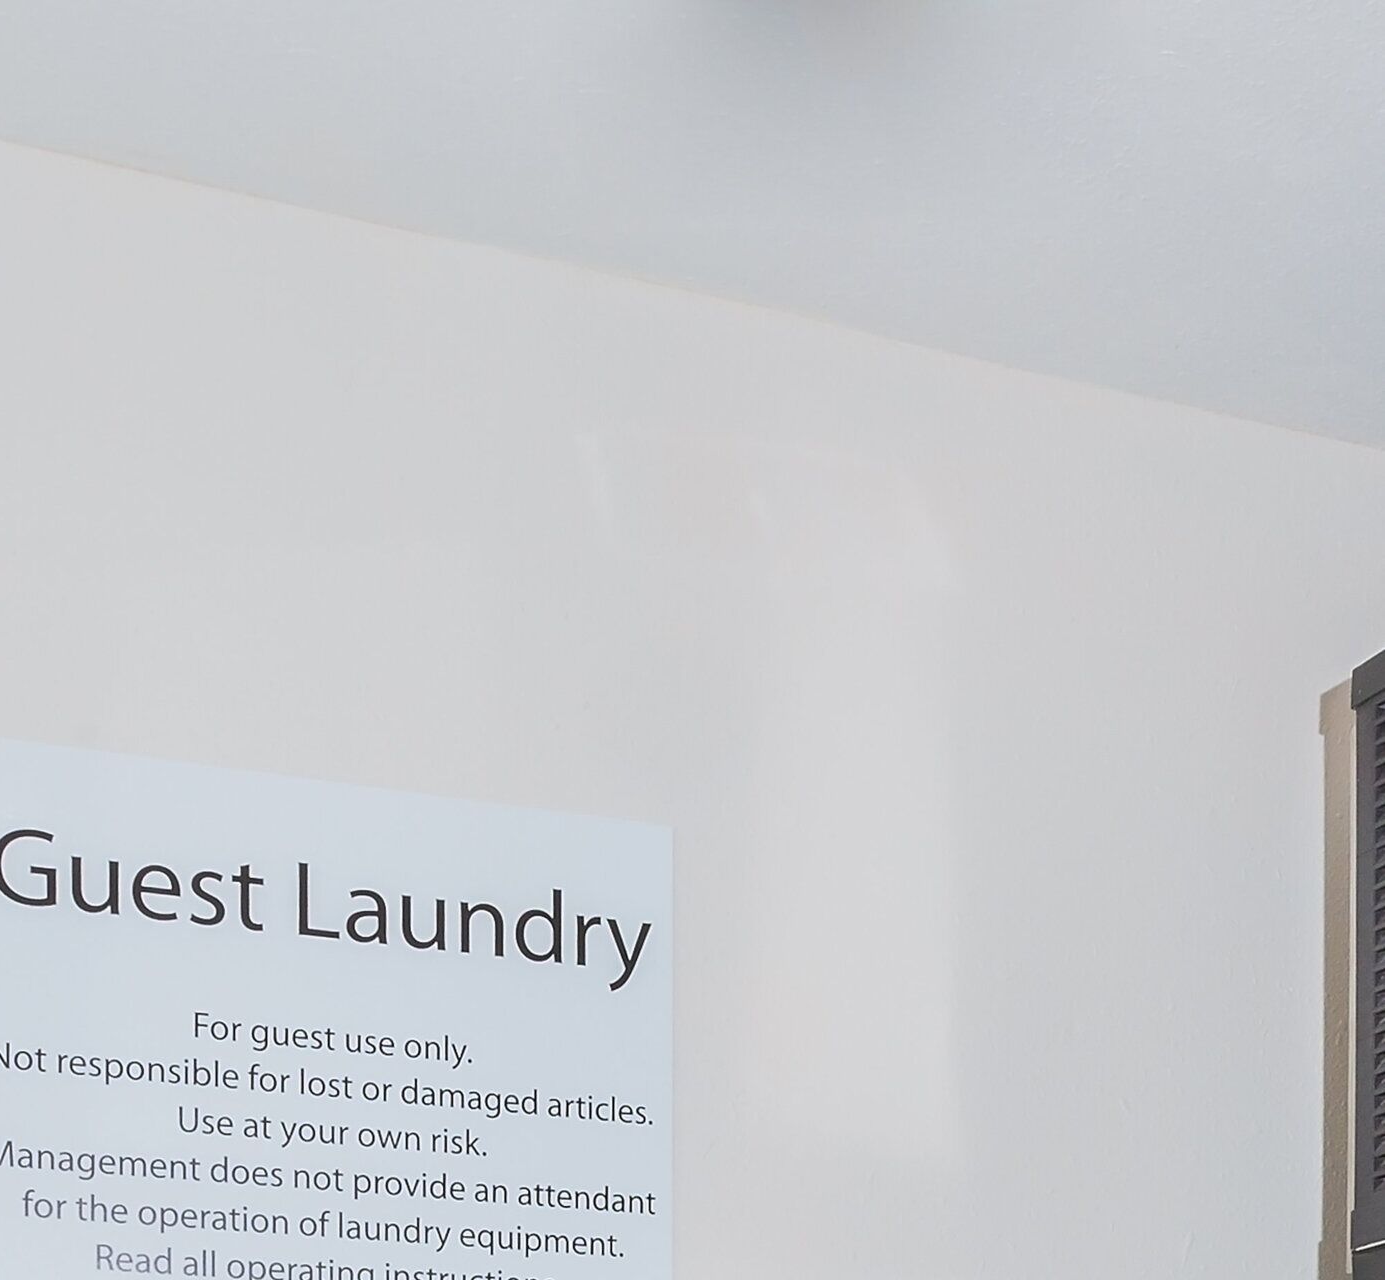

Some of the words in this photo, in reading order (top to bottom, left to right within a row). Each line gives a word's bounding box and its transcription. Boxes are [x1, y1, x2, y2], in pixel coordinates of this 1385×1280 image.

[298, 862, 652, 992] Laundry
[194, 1012, 242, 1042] For
[251, 1025, 336, 1051] guest
[346, 1033, 395, 1056] use
[404, 1035, 472, 1069] only.
[58, 1054, 239, 1089] responsible
[247, 1063, 290, 1093] for
[301, 1068, 353, 1099] lost
[362, 1082, 393, 1102] or
[401, 1078, 538, 1119] damaged
[548, 1095, 653, 1125] articles.
[179, 1106, 233, 1136] Use
[244, 1116, 272, 1139] at
[280, 1121, 349, 1148] your
[358, 1128, 420, 1151] own
[432, 1128, 487, 1157] risk.
[210, 1156, 283, 1187] does
[294, 1169, 344, 1192] not
[354, 1173, 465, 1201] provide
[475, 1183, 507, 1204] an
[518, 1184, 656, 1215] attendant
[22, 1189, 67, 1219] for
[75, 1194, 128, 1224] the
[138, 1206, 288, 1235] operation
[299, 1210, 331, 1237] of
[339, 1211, 451, 1252] laundry
[460, 1225, 624, 1258] equipment.
[96, 1244, 172, 1275] Read
[183, 1249, 215, 1277] all
